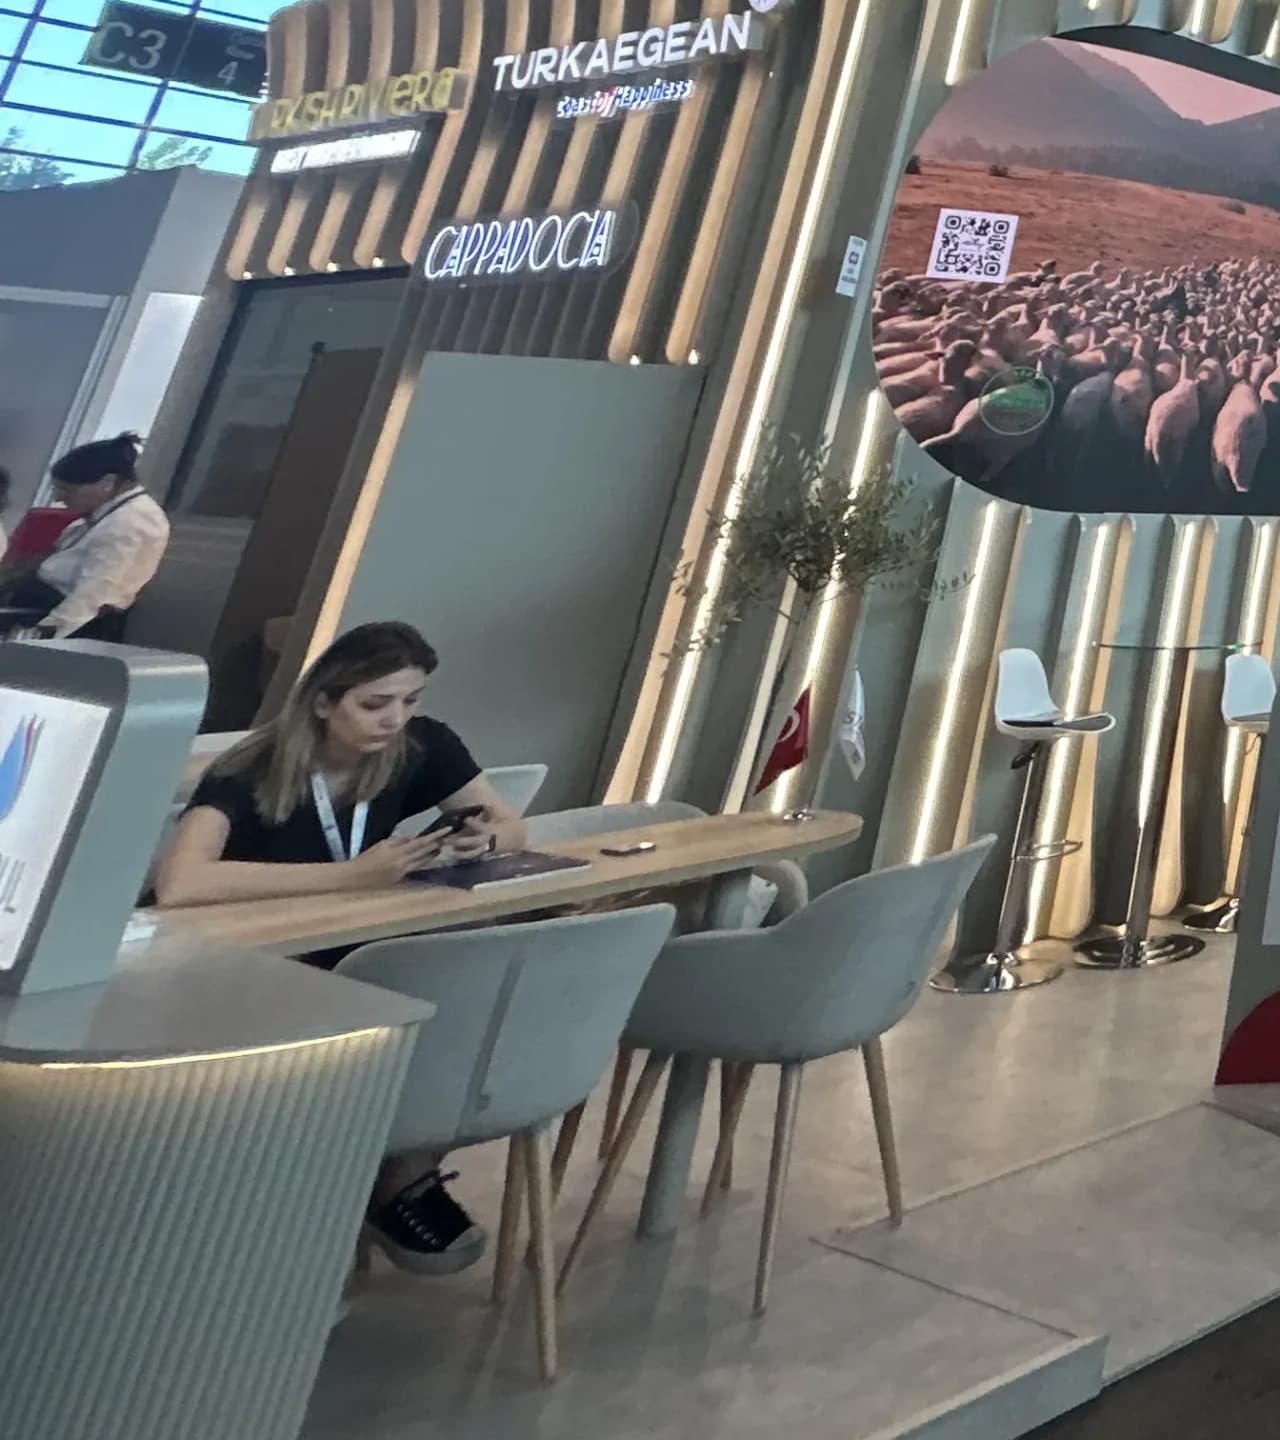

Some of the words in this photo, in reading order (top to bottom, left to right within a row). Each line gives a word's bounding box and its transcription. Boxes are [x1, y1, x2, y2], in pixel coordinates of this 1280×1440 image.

[93, 21, 168, 71] C3
[217, 61, 237, 86] 4
[493, 11, 751, 91] TURKAEGEAN
[424, 210, 616, 280] CAPPADOCIA
